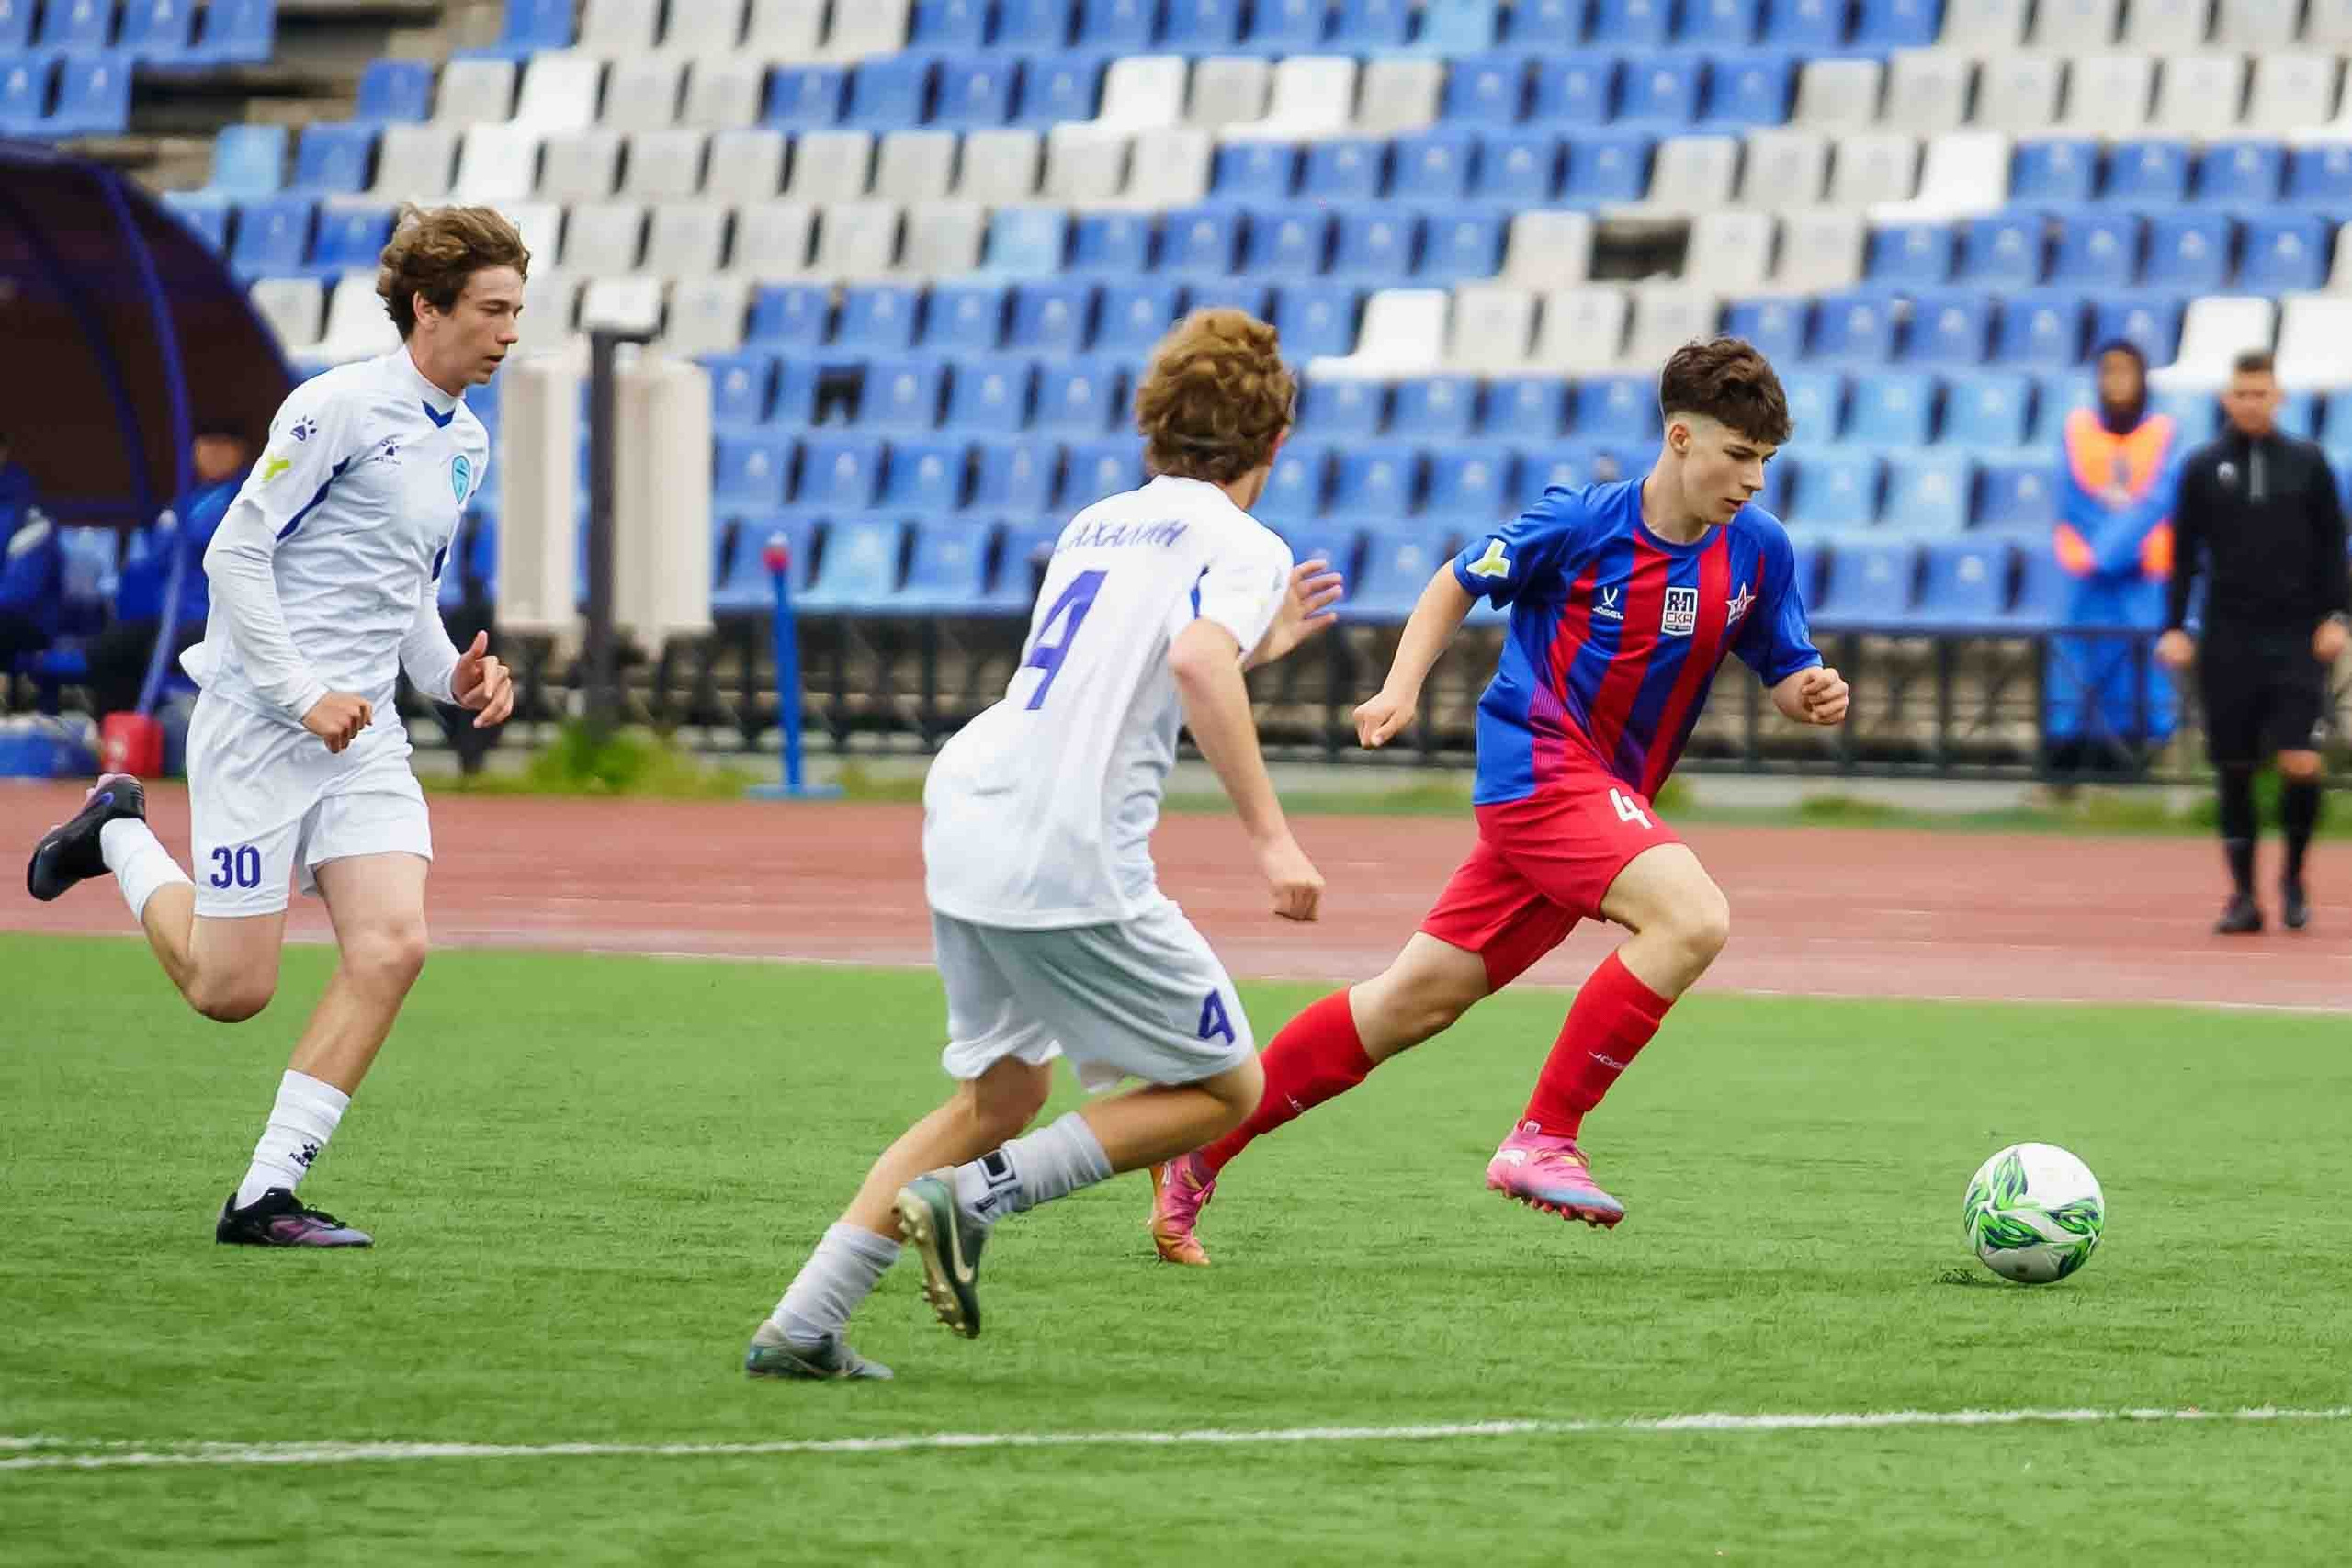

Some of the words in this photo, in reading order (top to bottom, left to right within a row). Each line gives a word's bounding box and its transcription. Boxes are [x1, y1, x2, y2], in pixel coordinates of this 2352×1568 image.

[1022, 569, 1110, 710] 4
[1609, 787, 1654, 829] 4
[210, 843, 261, 889] 30
[1197, 988, 1236, 1045] 4
